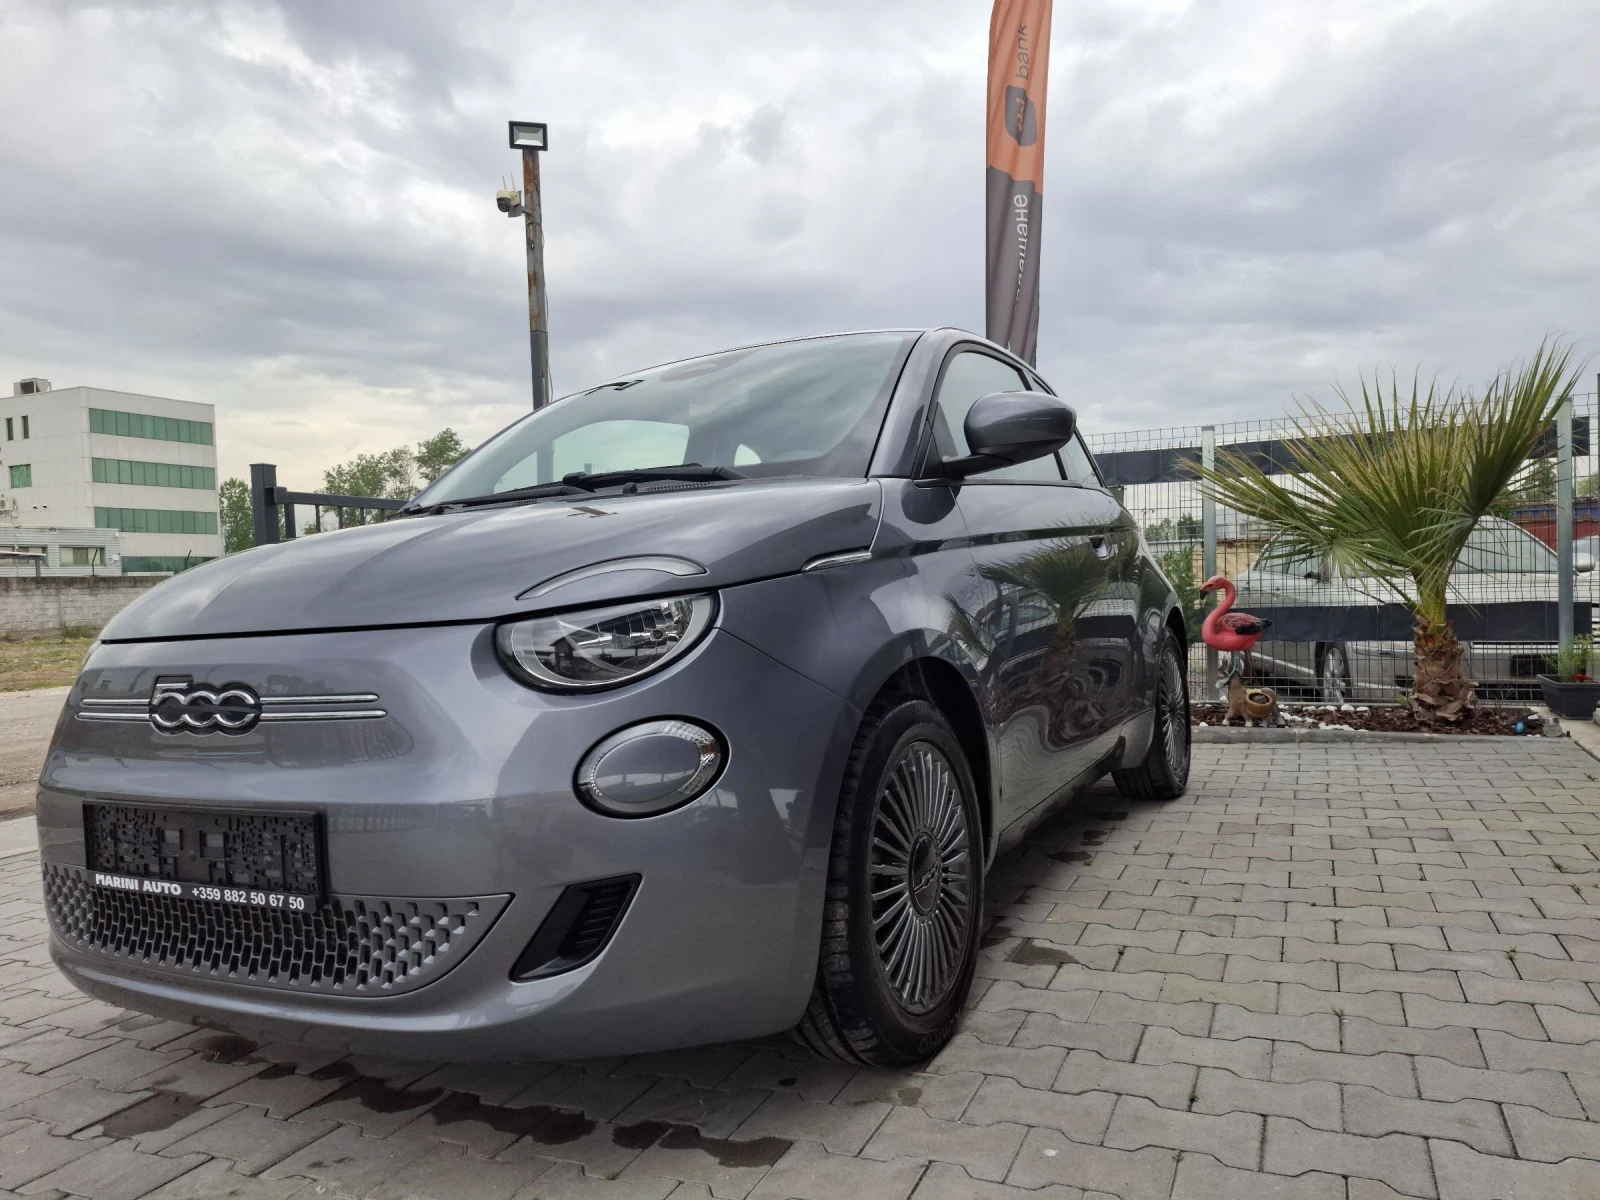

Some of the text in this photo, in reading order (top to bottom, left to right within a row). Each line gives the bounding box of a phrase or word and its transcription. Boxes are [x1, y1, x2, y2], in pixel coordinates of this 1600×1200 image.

[1015, 24, 1029, 81] bank
[151, 682, 255, 728] 500
[94, 873, 305, 910] MARINI AUTO +359 882 50 67 50
